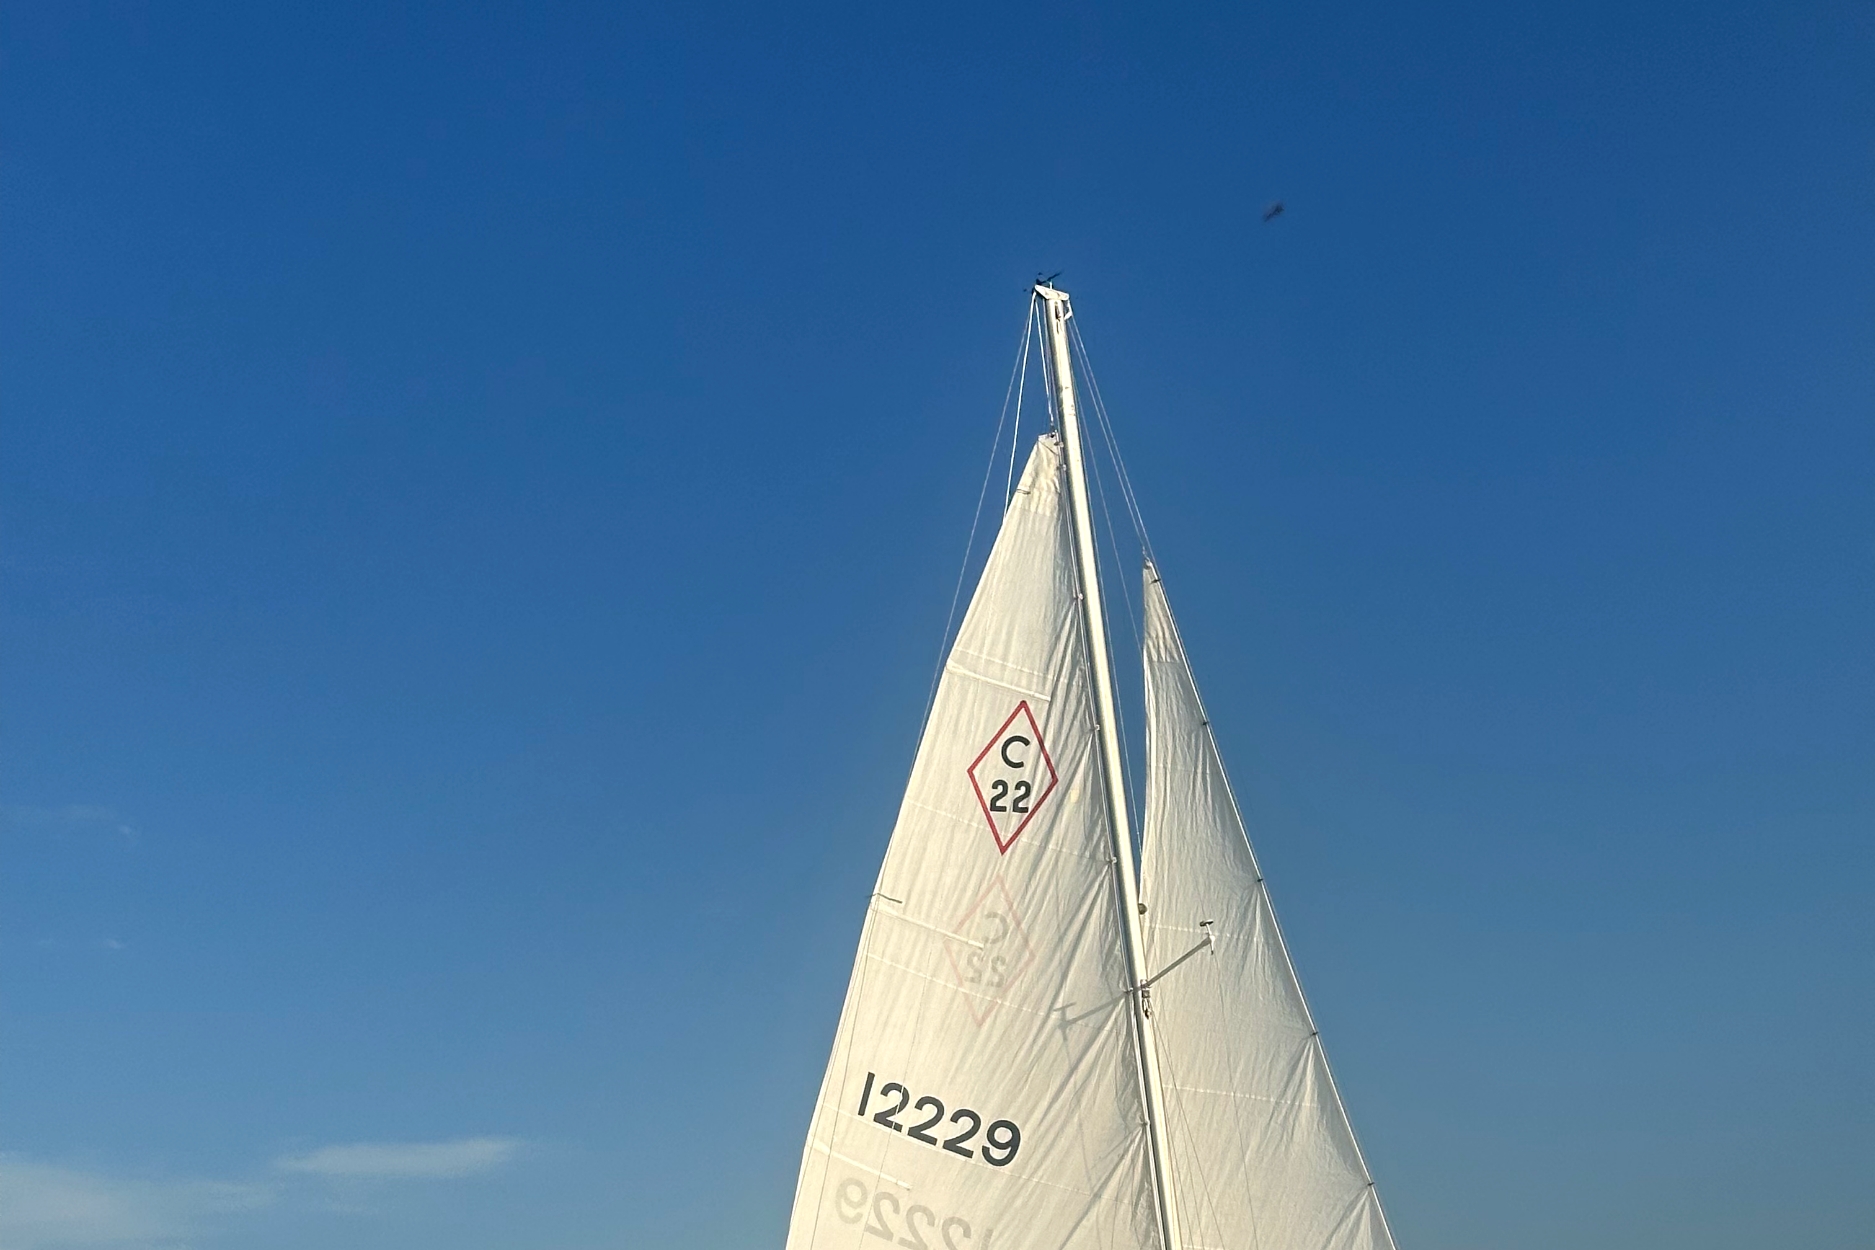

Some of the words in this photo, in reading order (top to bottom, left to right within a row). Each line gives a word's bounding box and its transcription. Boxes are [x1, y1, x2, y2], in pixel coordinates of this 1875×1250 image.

[1001, 735, 1030, 769] C
[989, 779, 1031, 813] 22
[857, 1071, 1021, 1167] 12229
